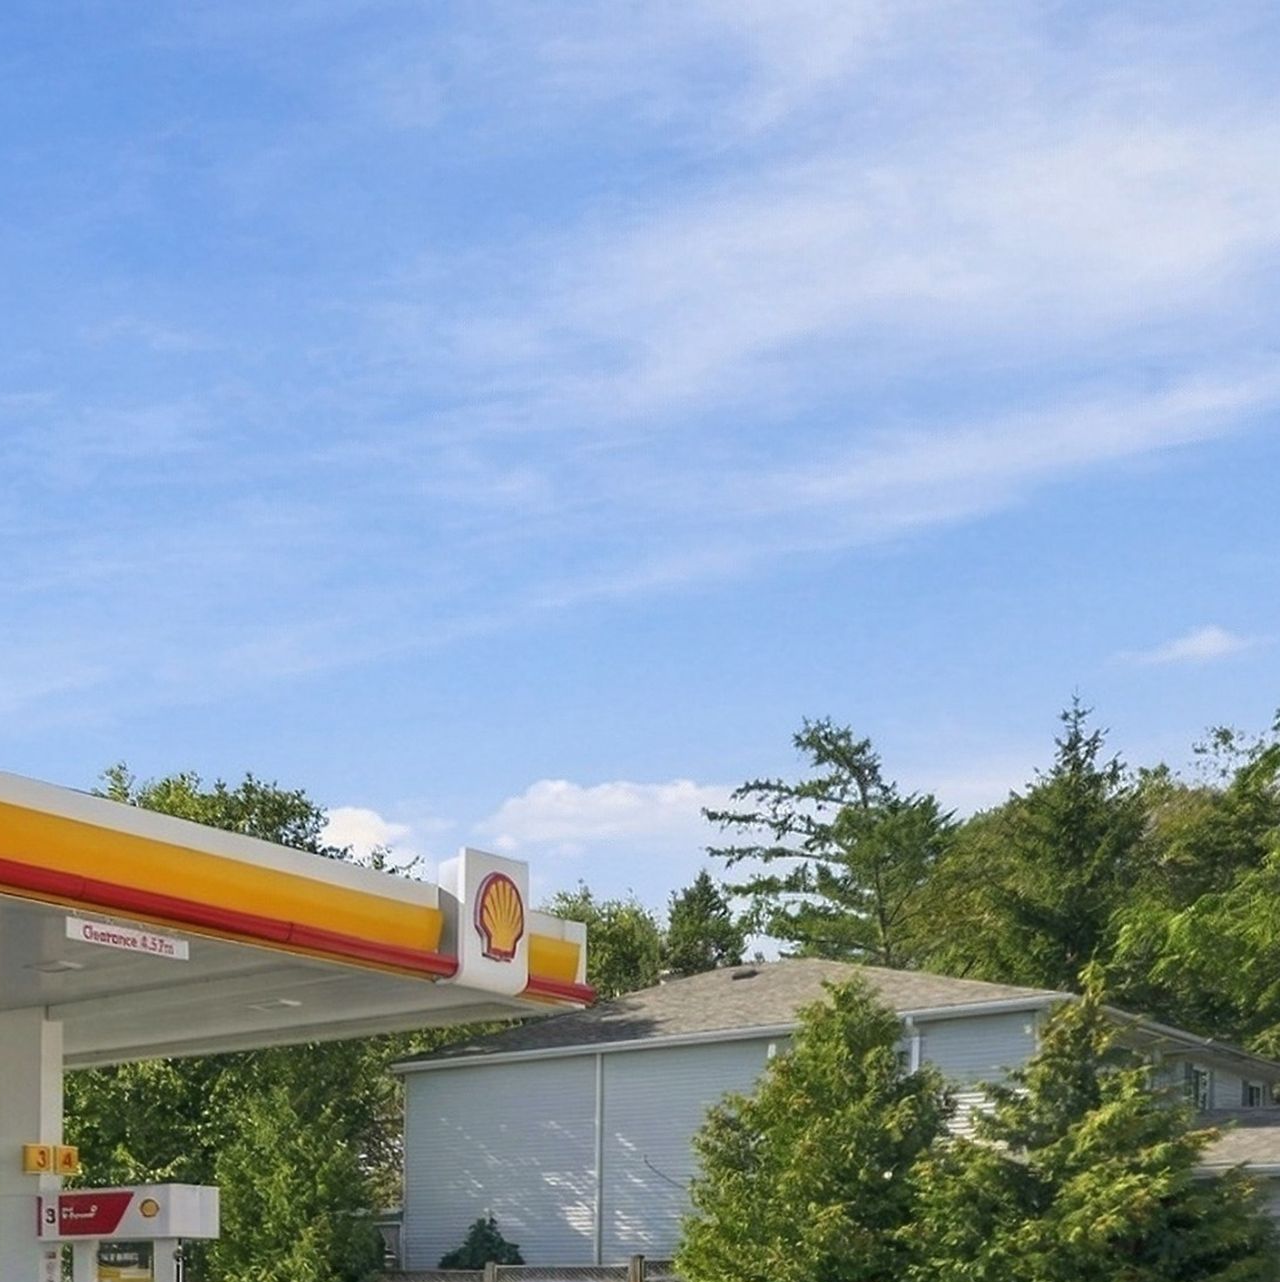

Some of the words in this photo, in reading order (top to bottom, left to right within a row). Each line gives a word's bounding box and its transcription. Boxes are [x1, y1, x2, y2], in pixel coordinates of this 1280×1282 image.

[82, 924, 138, 948] Clearance
[37, 1150, 47, 1168] 3
[62, 1152, 72, 1169] 4
[45, 1207, 56, 1224] 3
